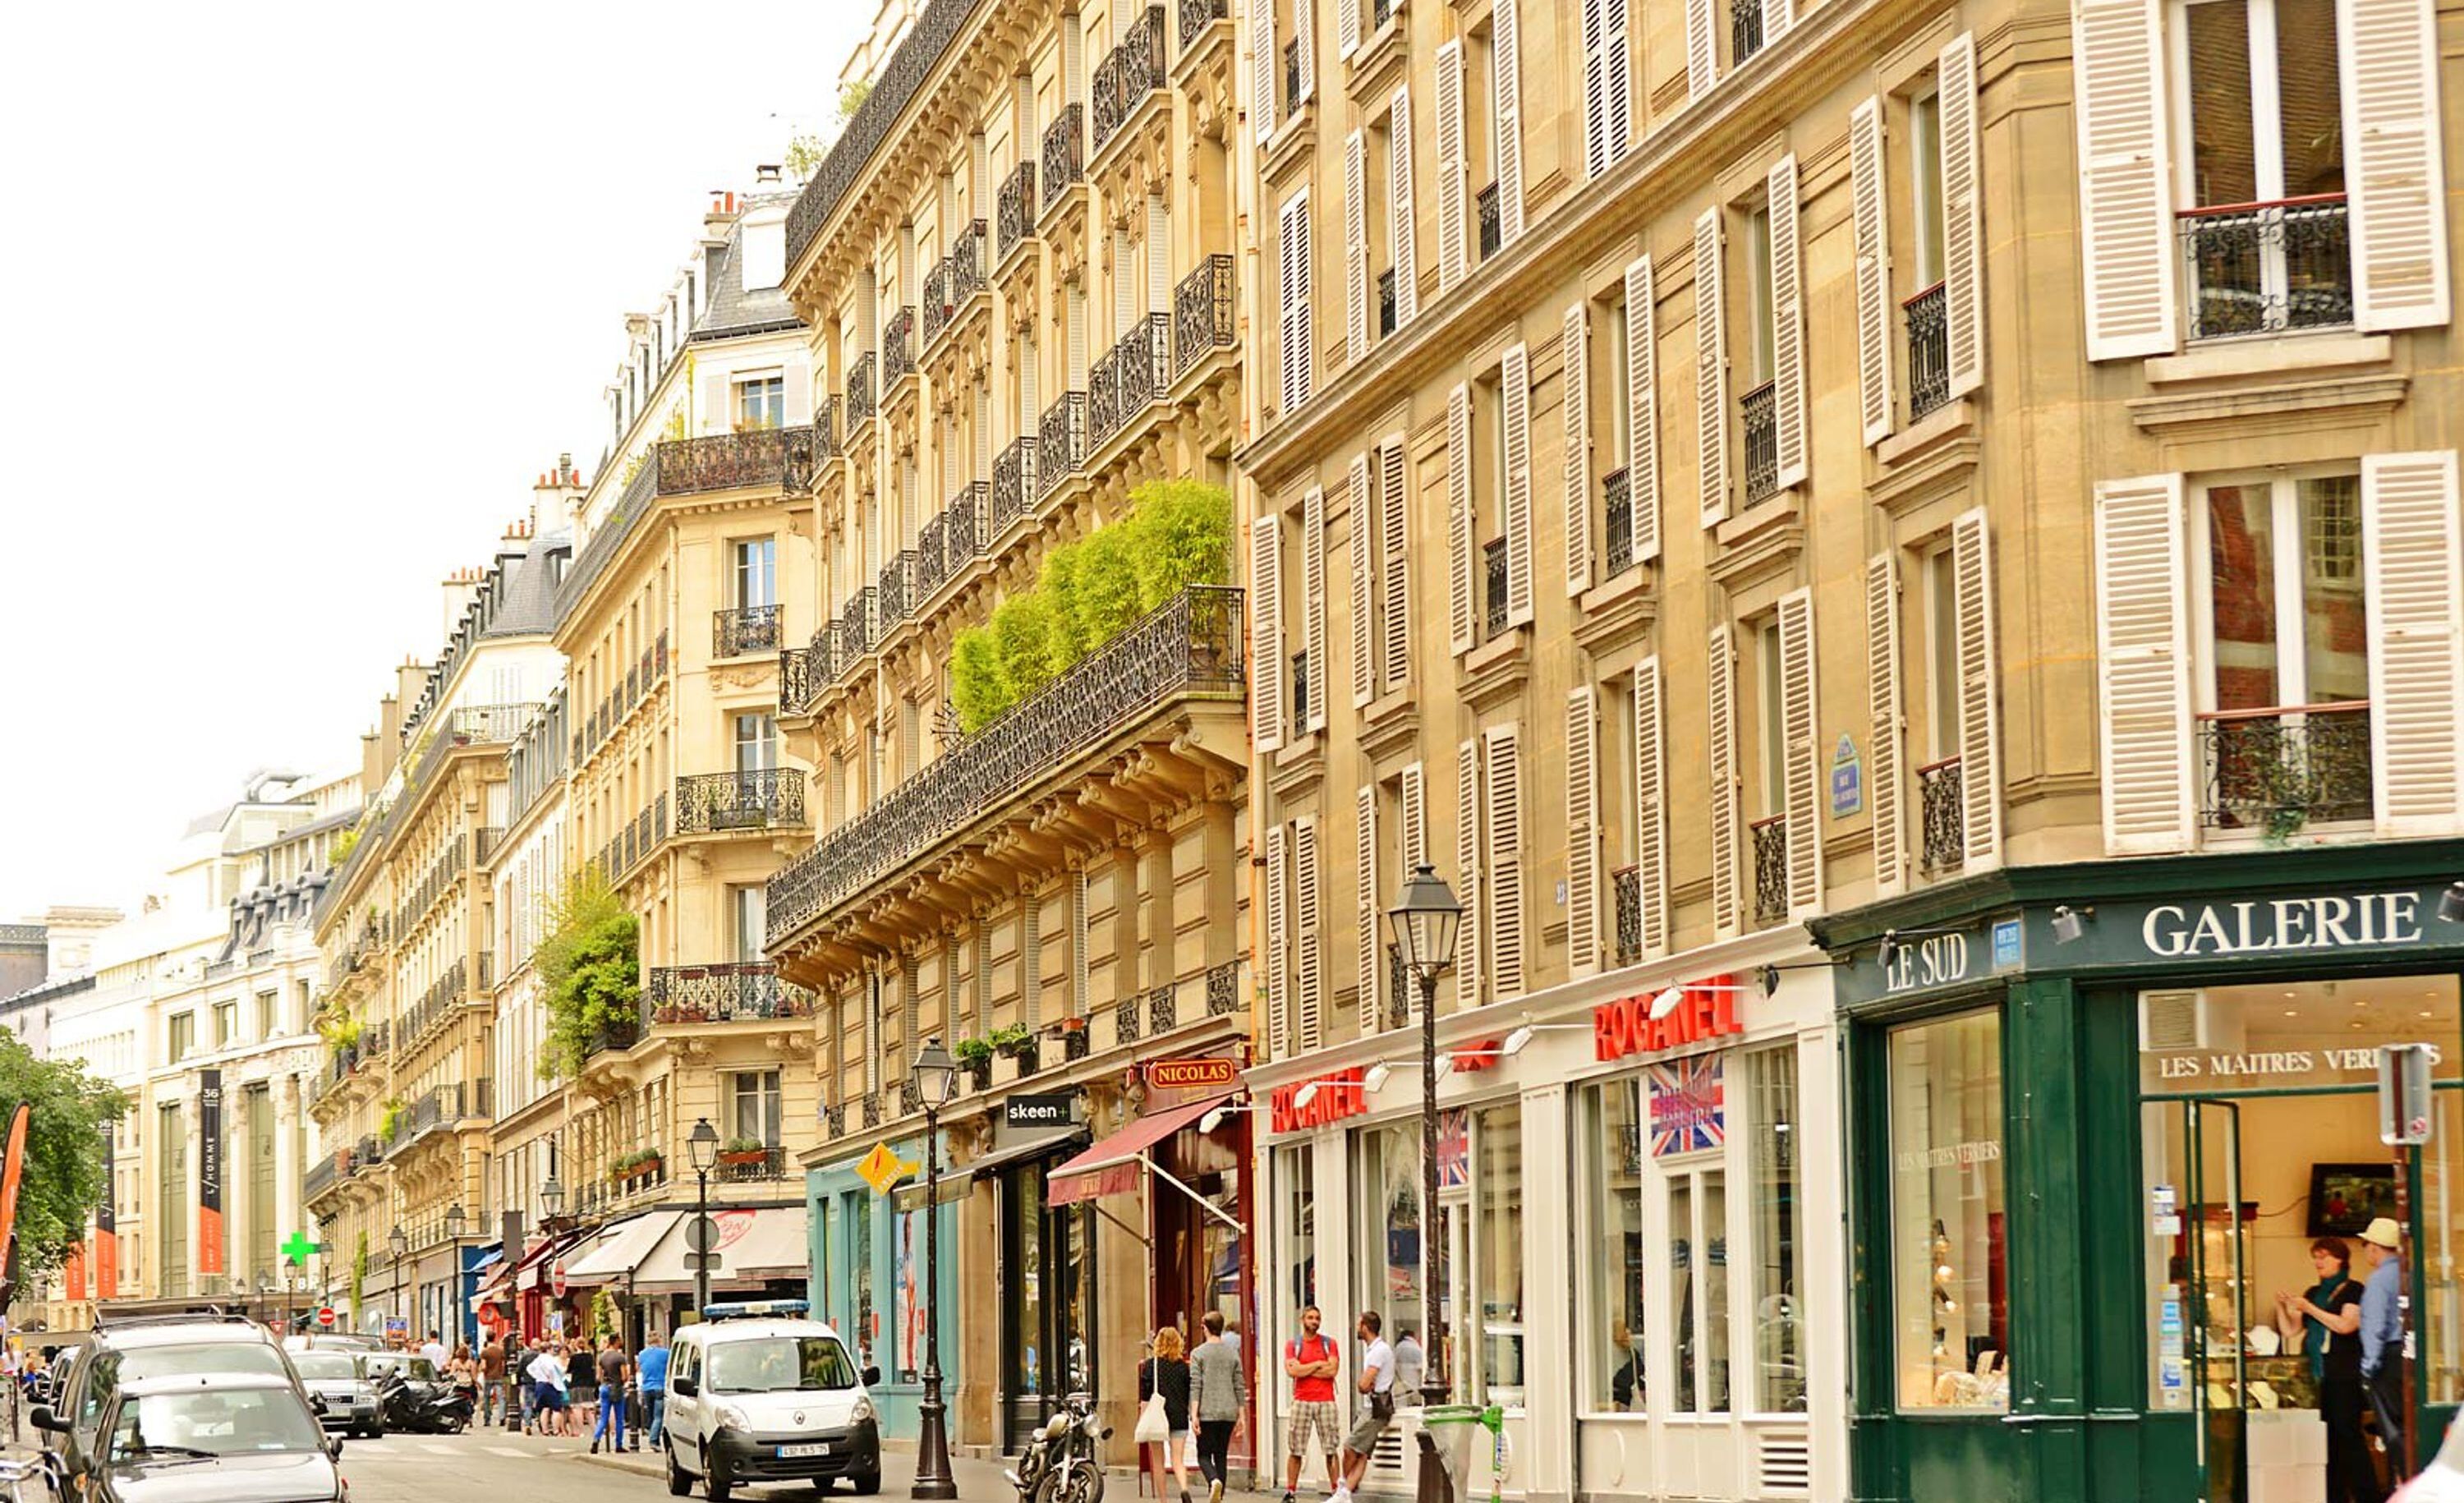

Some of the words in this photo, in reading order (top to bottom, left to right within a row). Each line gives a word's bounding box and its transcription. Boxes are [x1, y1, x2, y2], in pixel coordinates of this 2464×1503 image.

[2142, 891, 2423, 956] GALERIE
[1921, 933, 1967, 986] SUD
[1158, 1064, 1229, 1082] NICOLAS
[2160, 1057, 2200, 1078] LES
[2210, 1051, 2314, 1076] MAITRES
